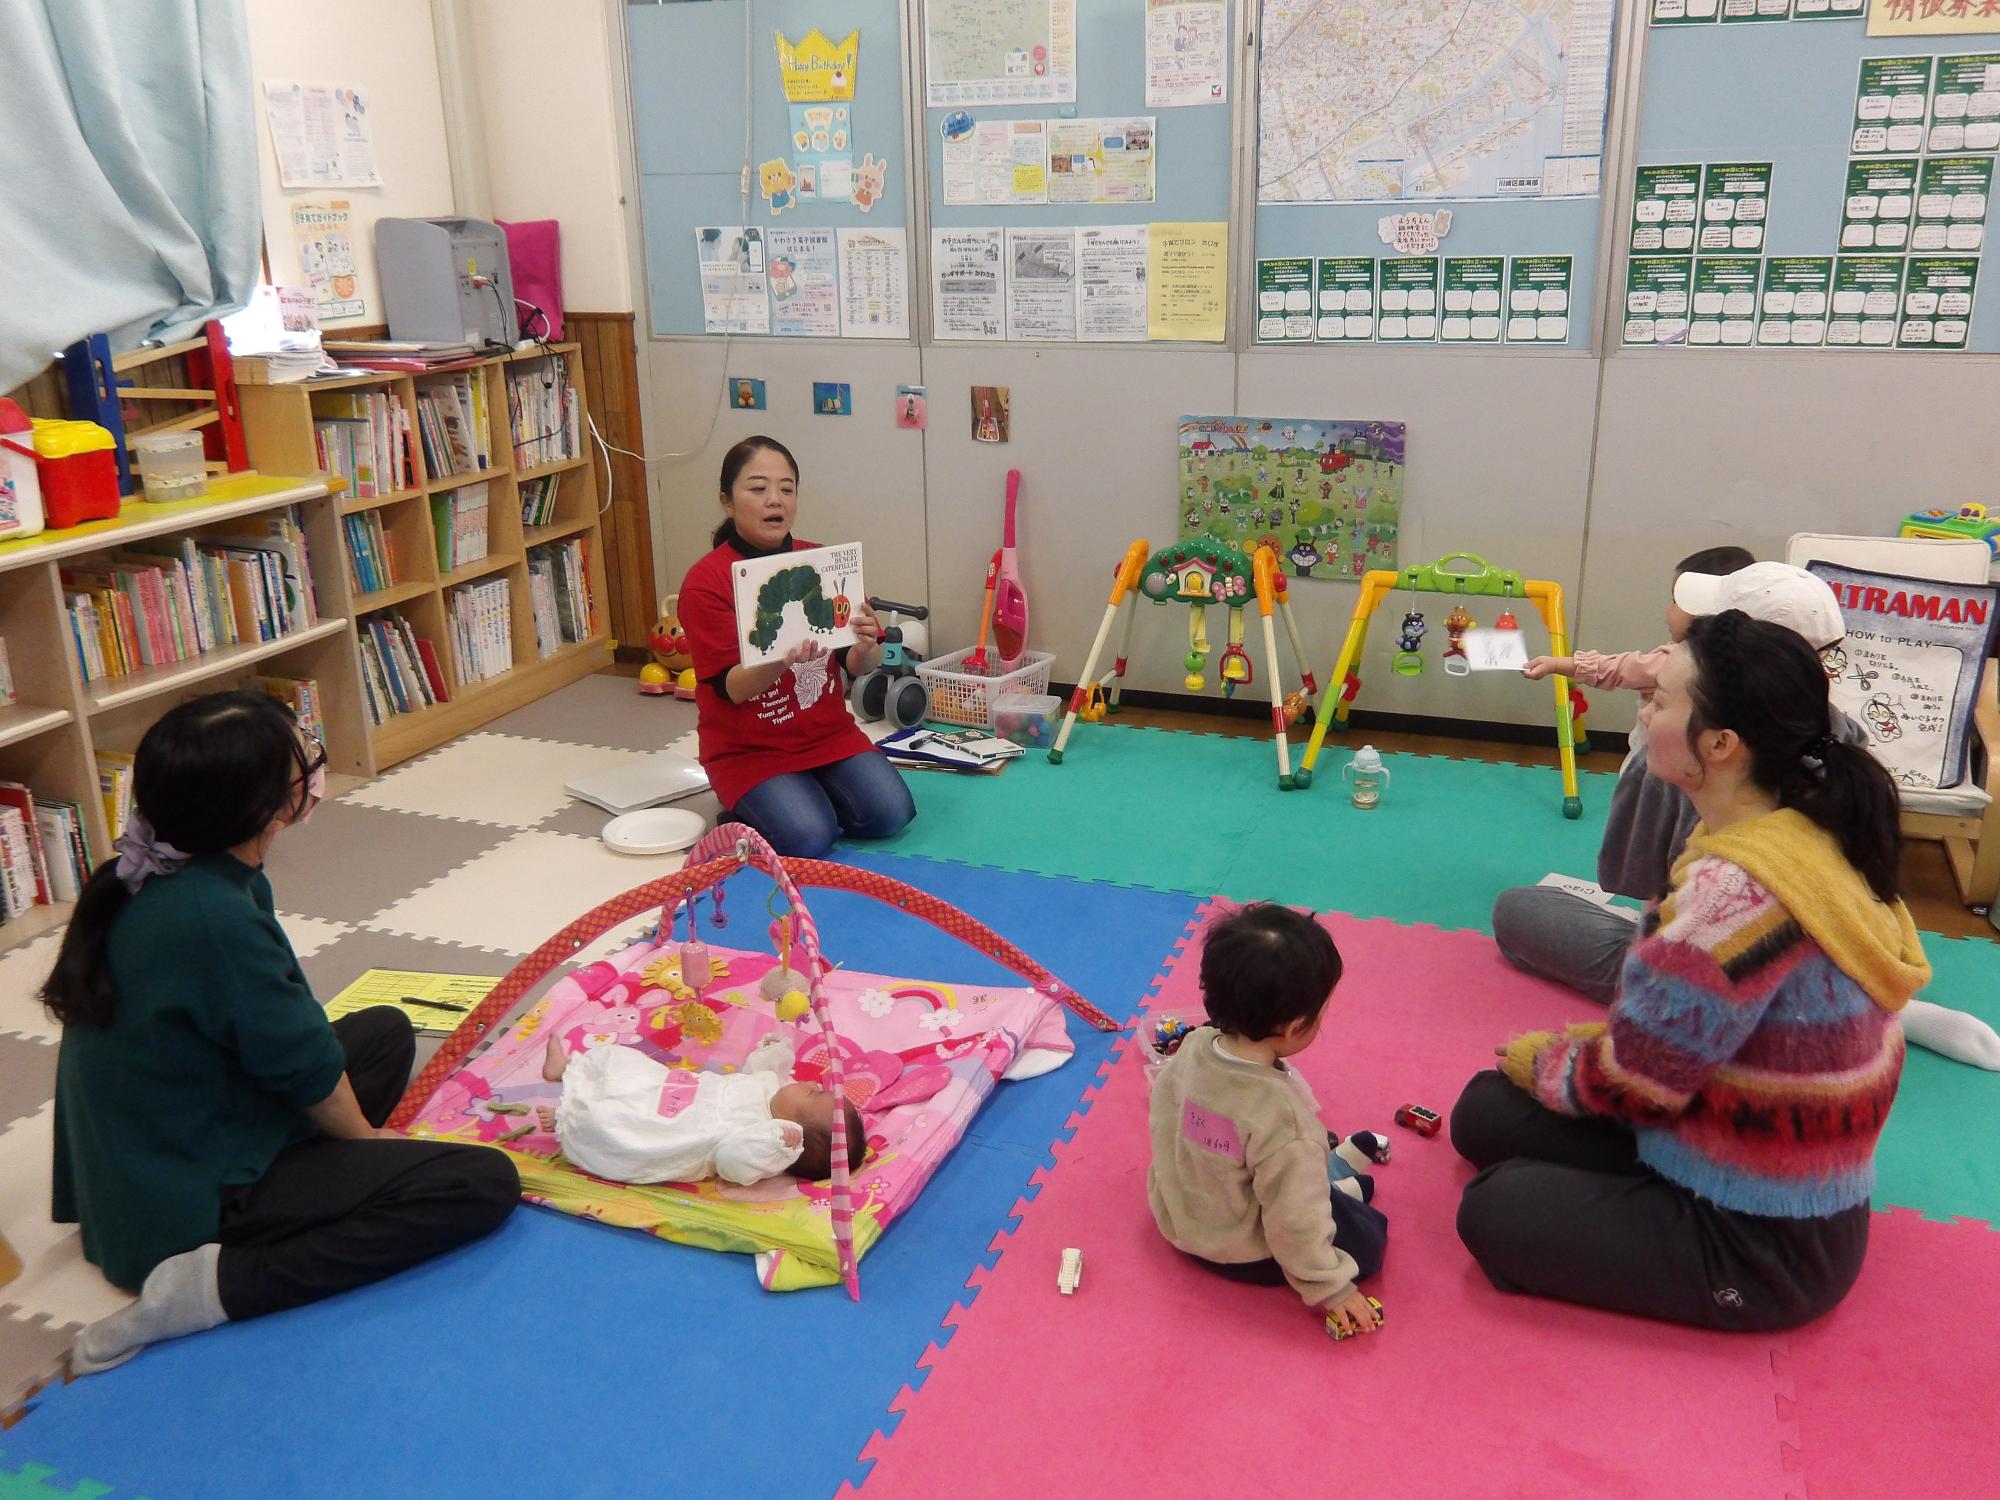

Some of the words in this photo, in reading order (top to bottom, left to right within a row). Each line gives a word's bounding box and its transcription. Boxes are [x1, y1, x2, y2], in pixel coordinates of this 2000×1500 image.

[1827, 580, 1989, 625] LTRAMAN
[1845, 628, 1876, 641] HOW
[1880, 634, 1892, 643] to
[1897, 636, 1933, 649] PLAY
[757, 709, 776, 719] Yumi
